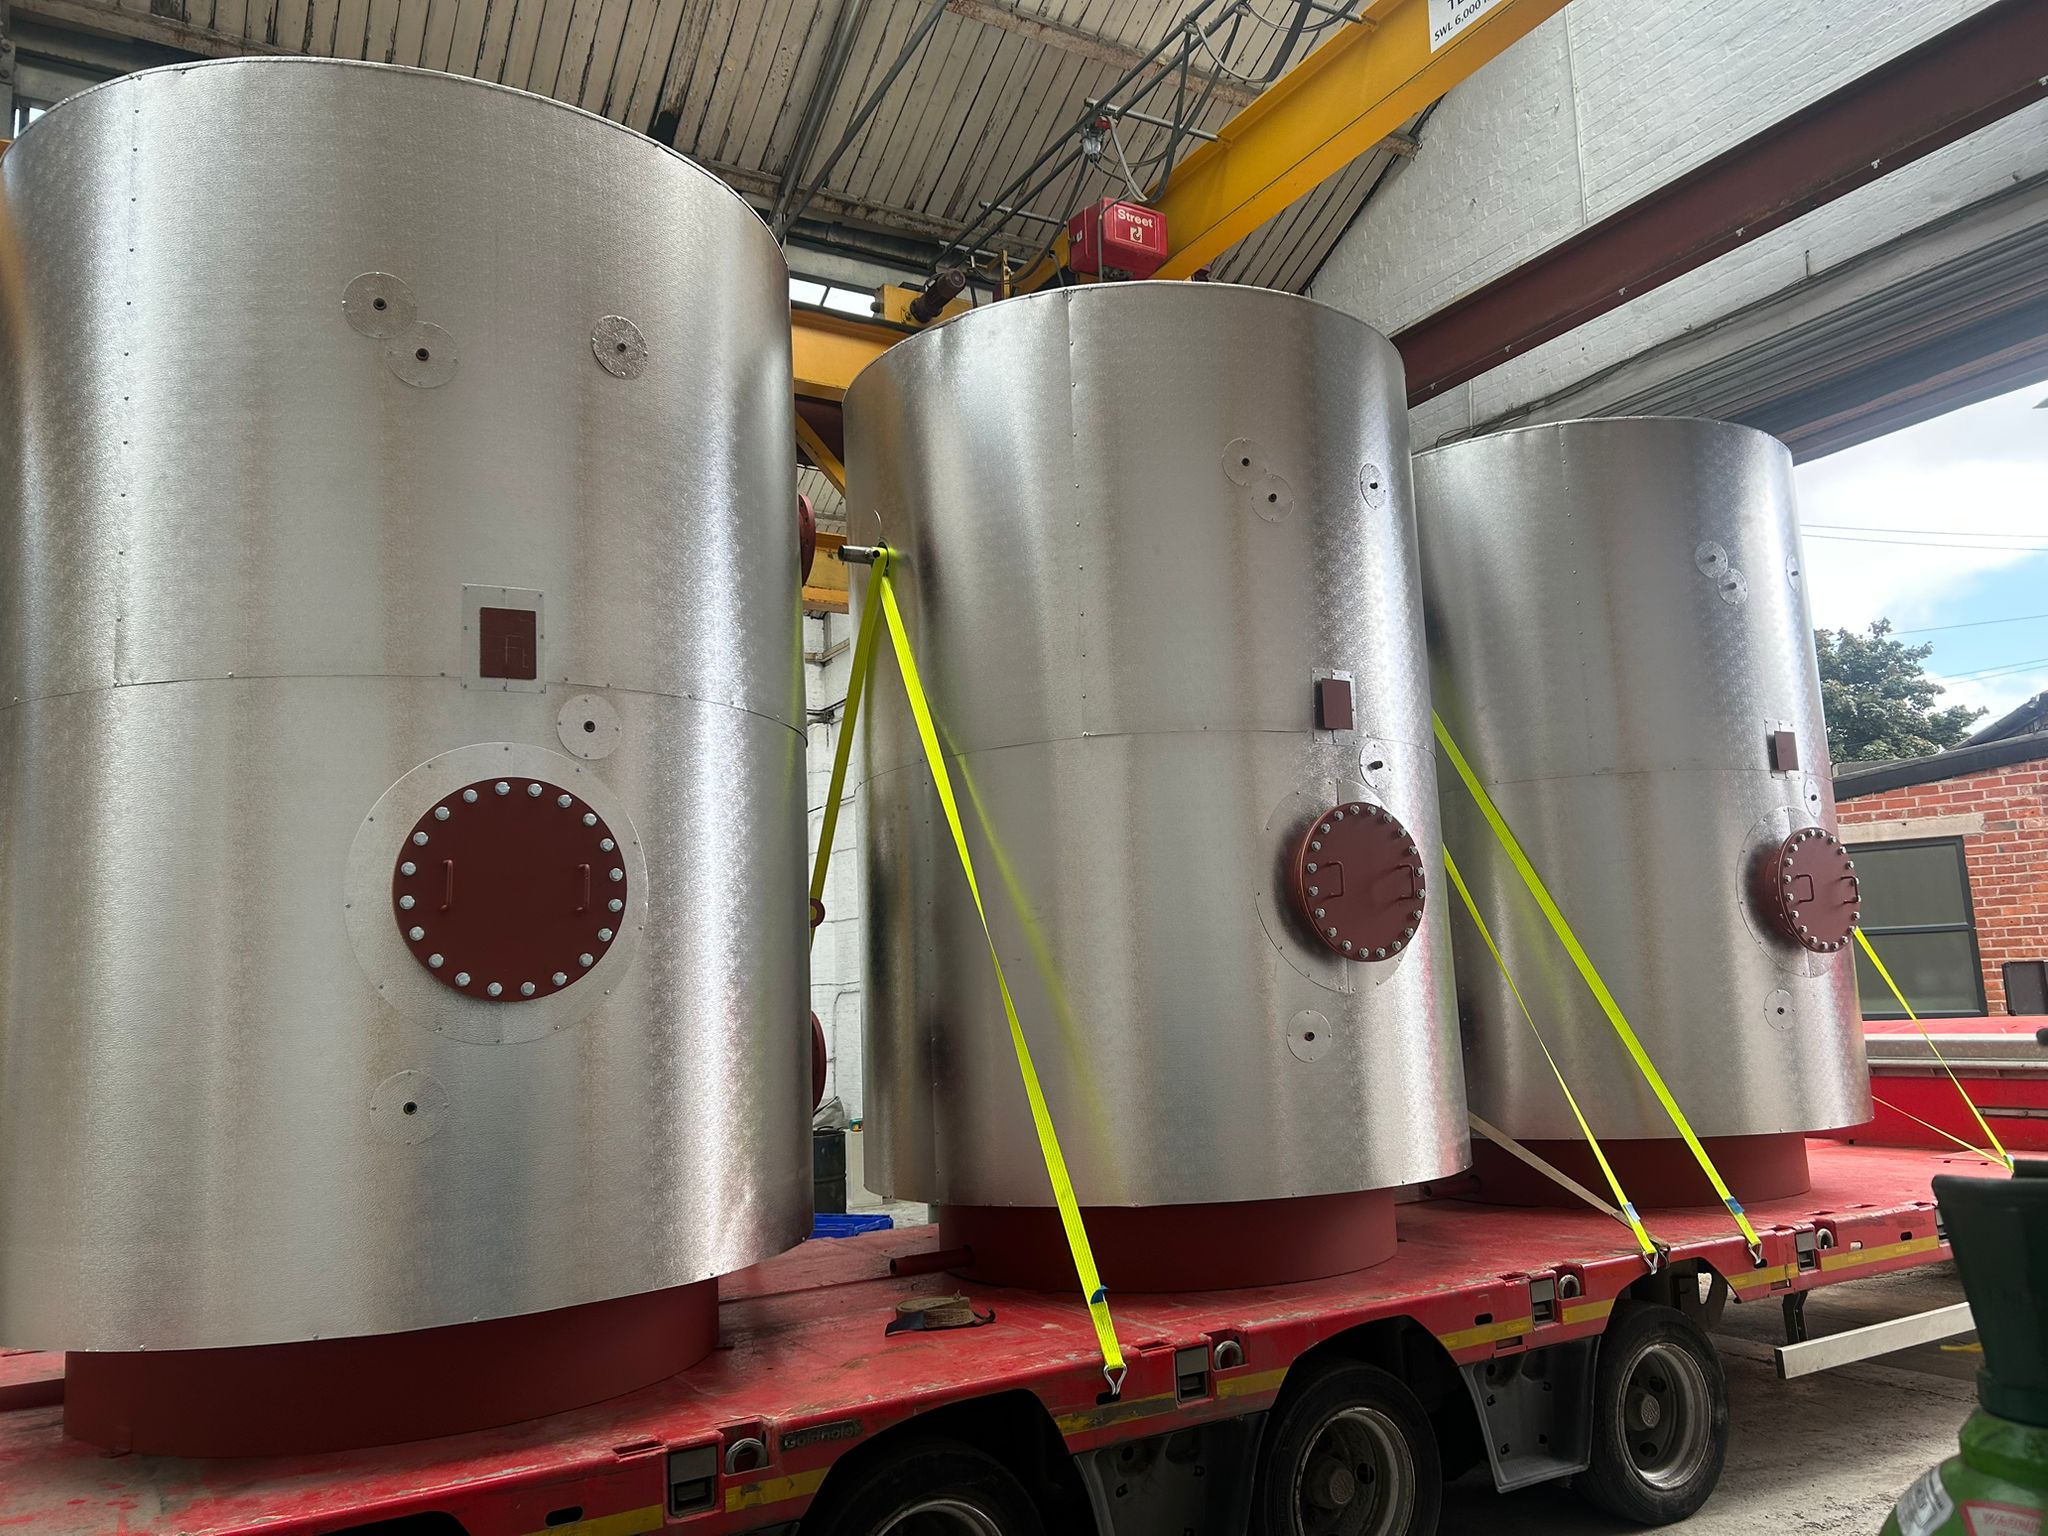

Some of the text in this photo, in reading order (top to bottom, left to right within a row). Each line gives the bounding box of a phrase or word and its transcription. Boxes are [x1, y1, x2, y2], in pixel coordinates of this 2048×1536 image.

[1434, 0, 1481, 42] SWL 6,000
[1117, 208, 1153, 228] Street
